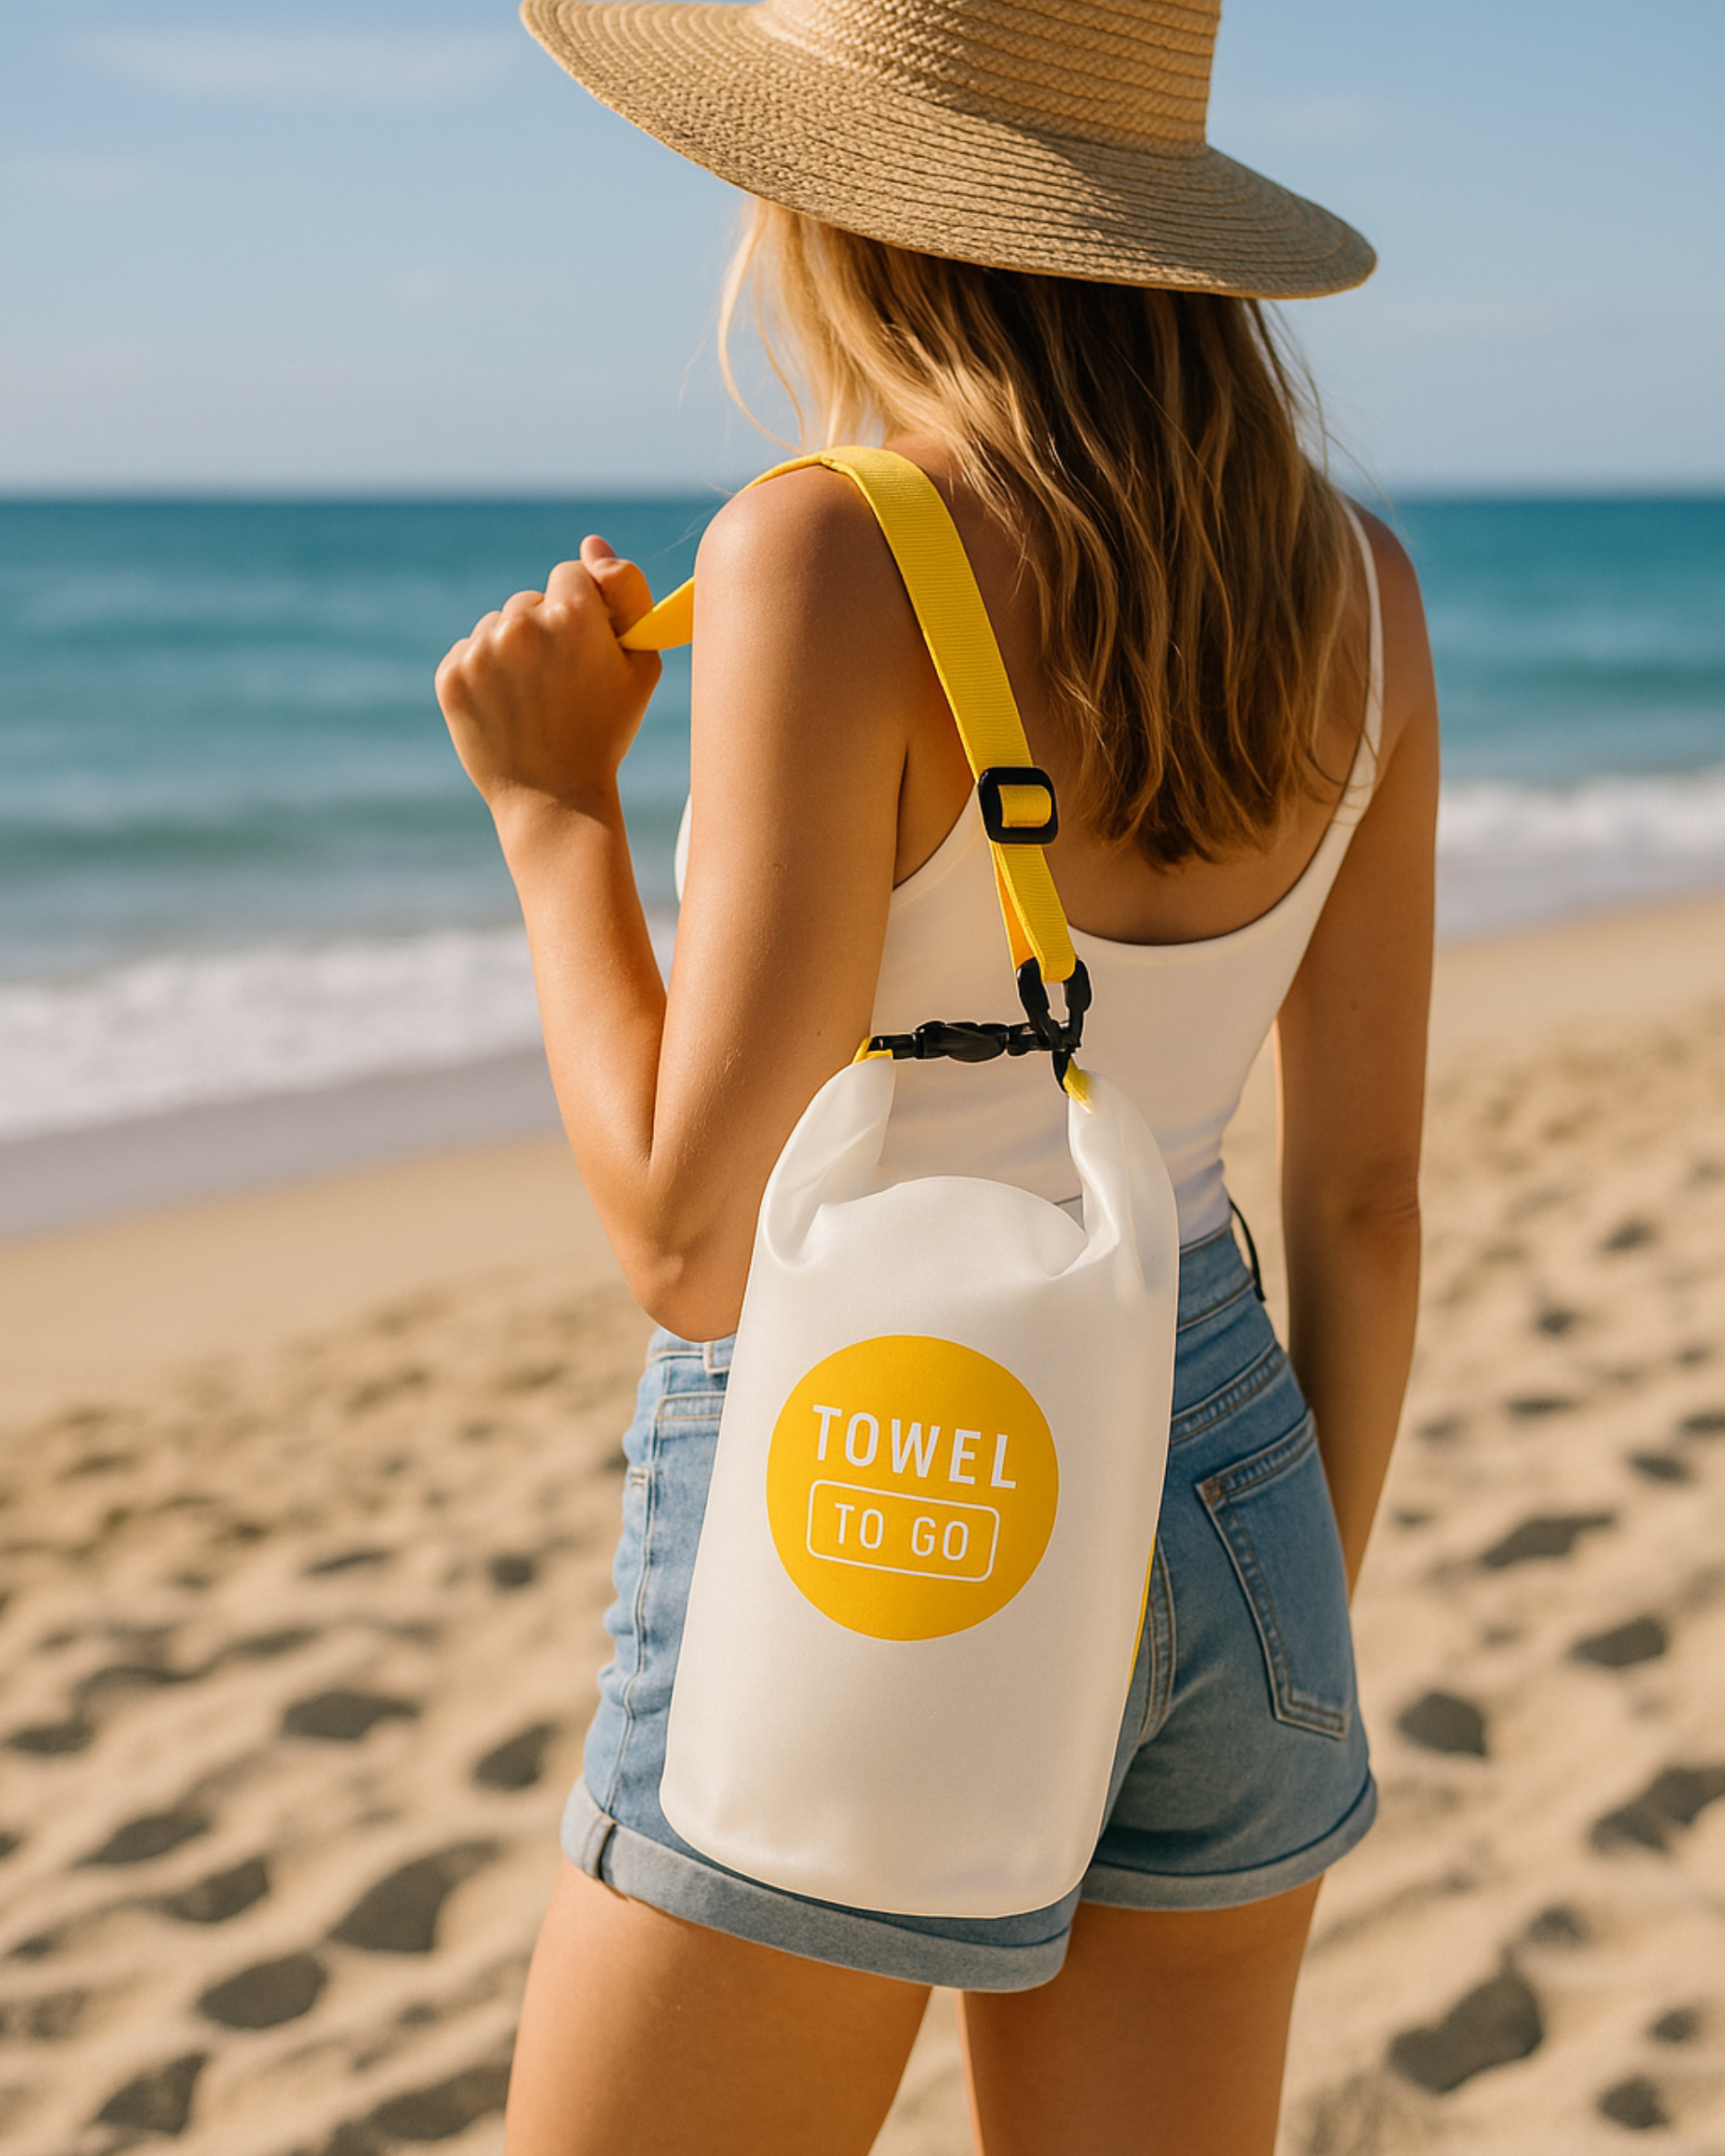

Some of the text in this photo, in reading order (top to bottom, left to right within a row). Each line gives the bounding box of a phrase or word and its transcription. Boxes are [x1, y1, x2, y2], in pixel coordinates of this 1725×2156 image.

[812, 1404, 1017, 1489] TOWEL
[835, 1502, 969, 1561] TO GO
